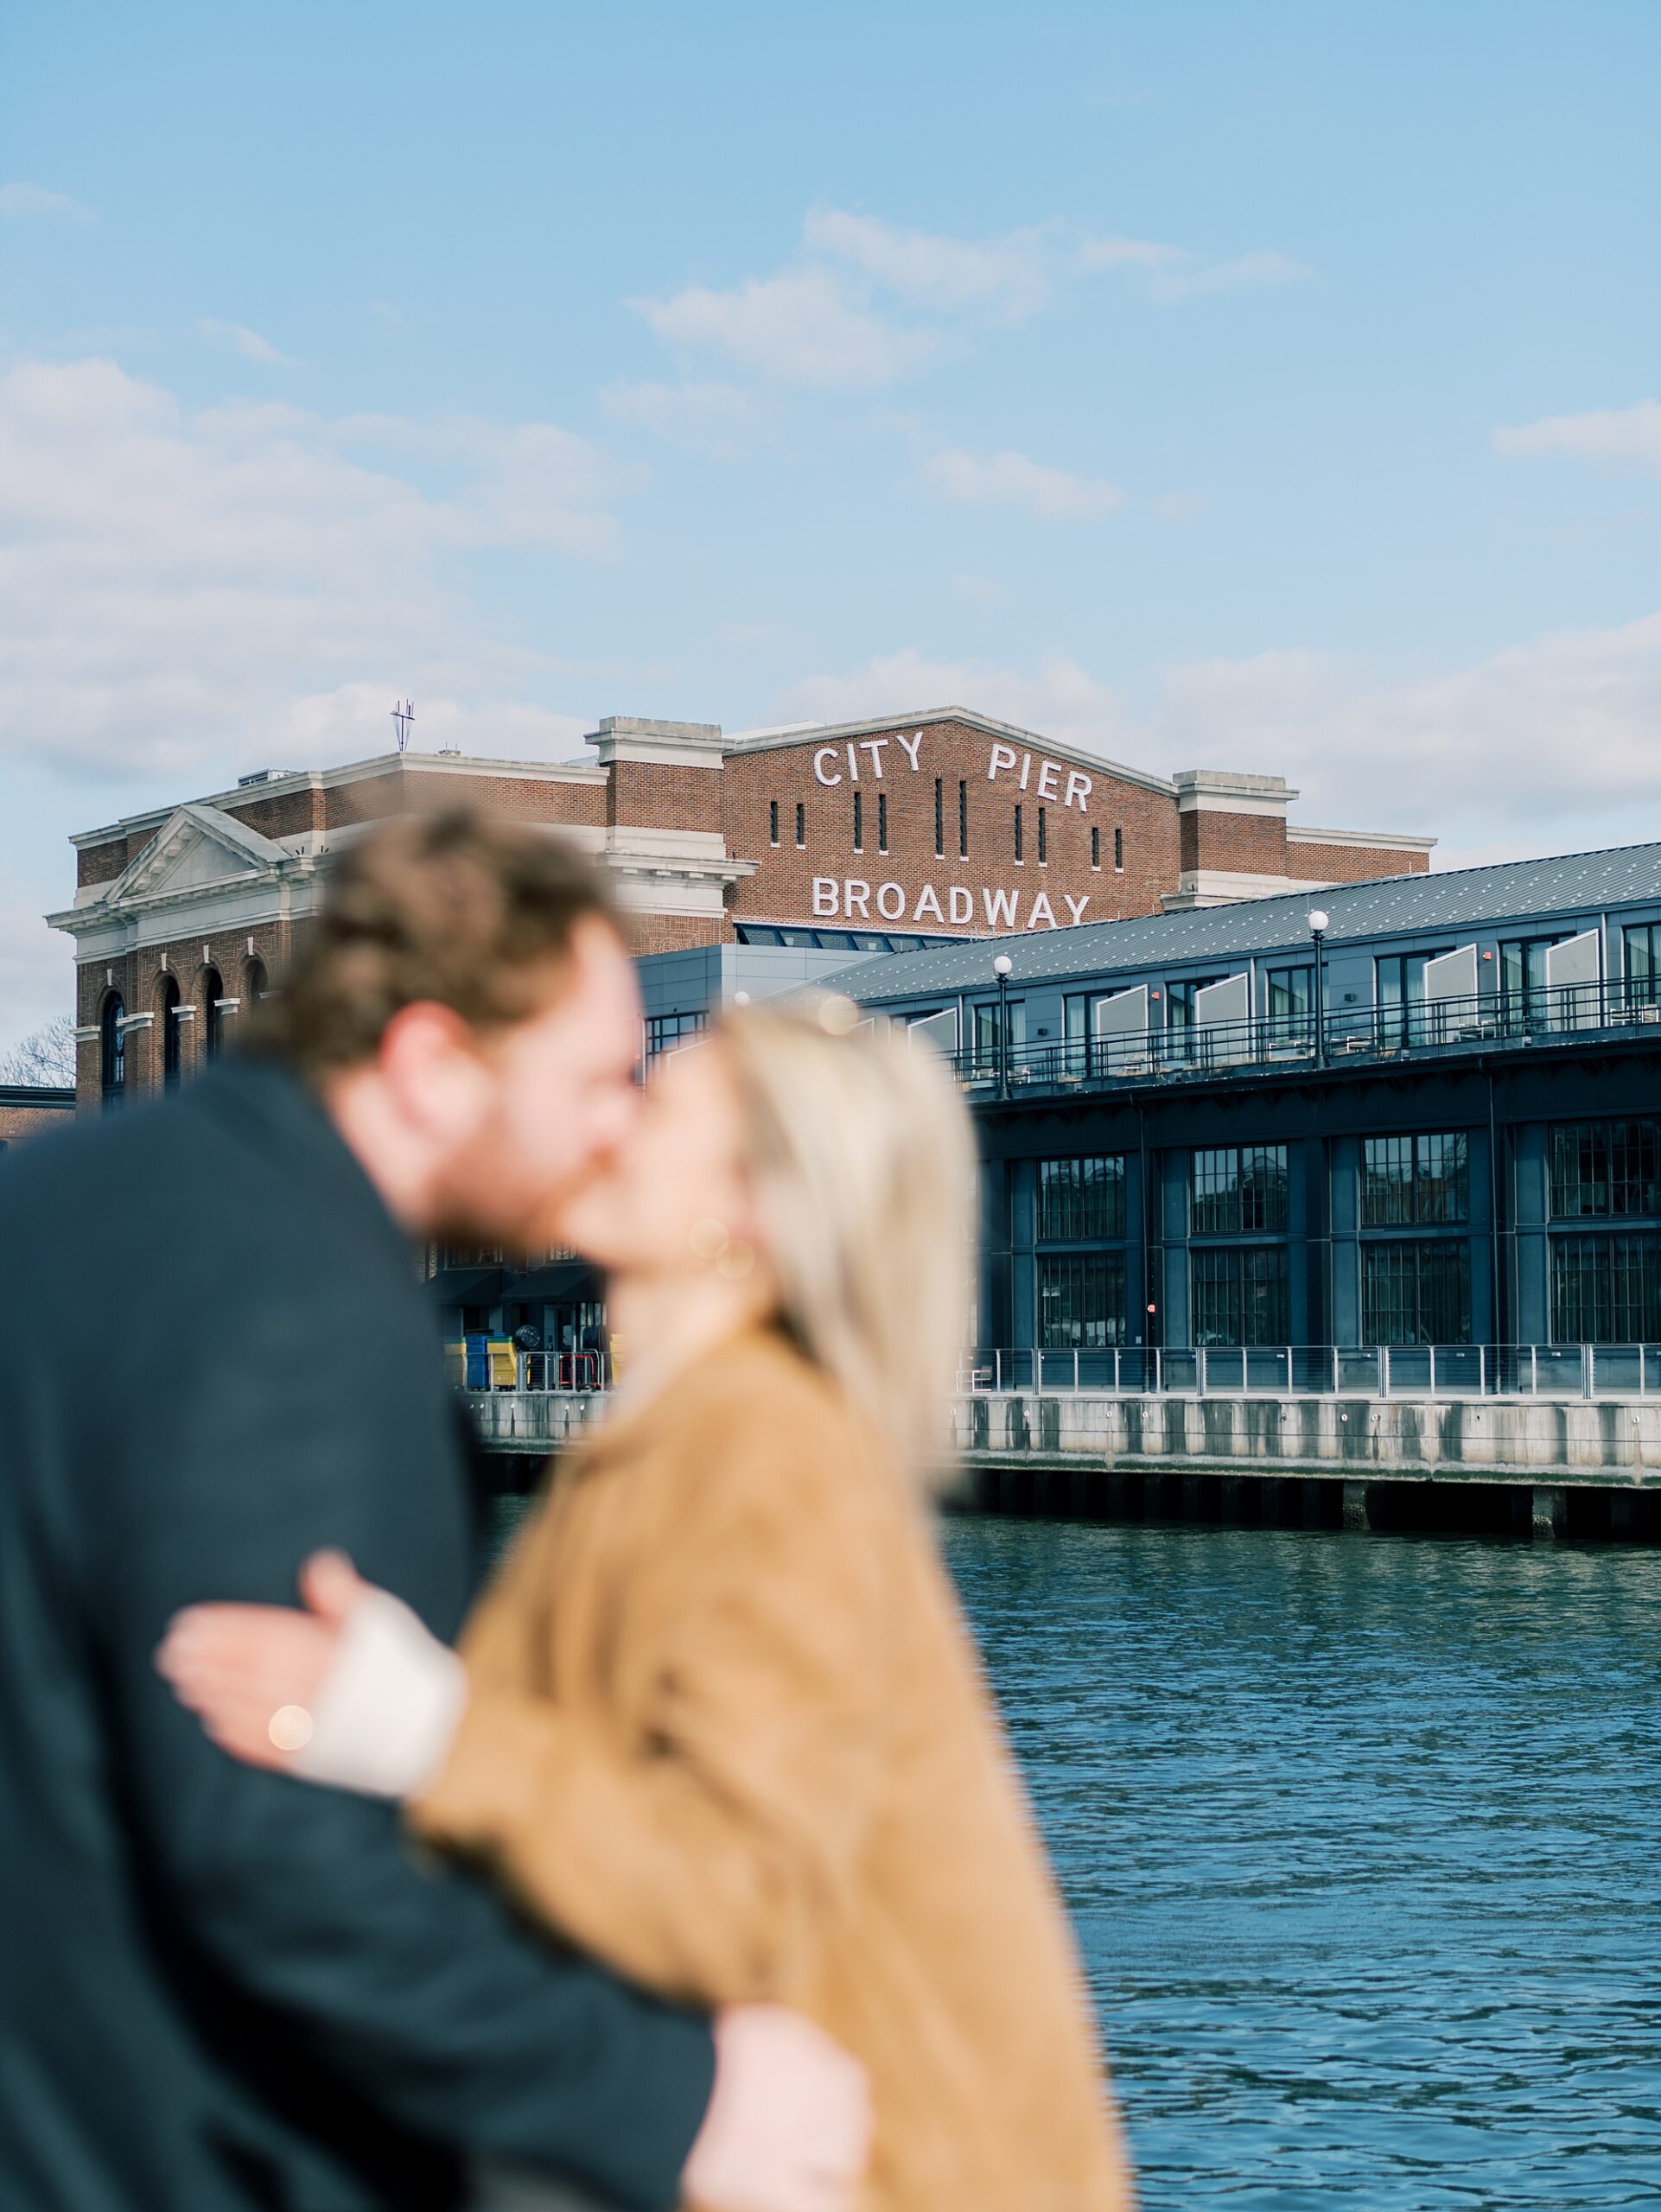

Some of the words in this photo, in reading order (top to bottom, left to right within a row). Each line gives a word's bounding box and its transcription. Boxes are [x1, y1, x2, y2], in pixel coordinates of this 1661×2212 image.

[813, 732, 924, 786] CITY
[988, 743, 1092, 812] PIER
[811, 877, 1091, 929] BROADWAY
